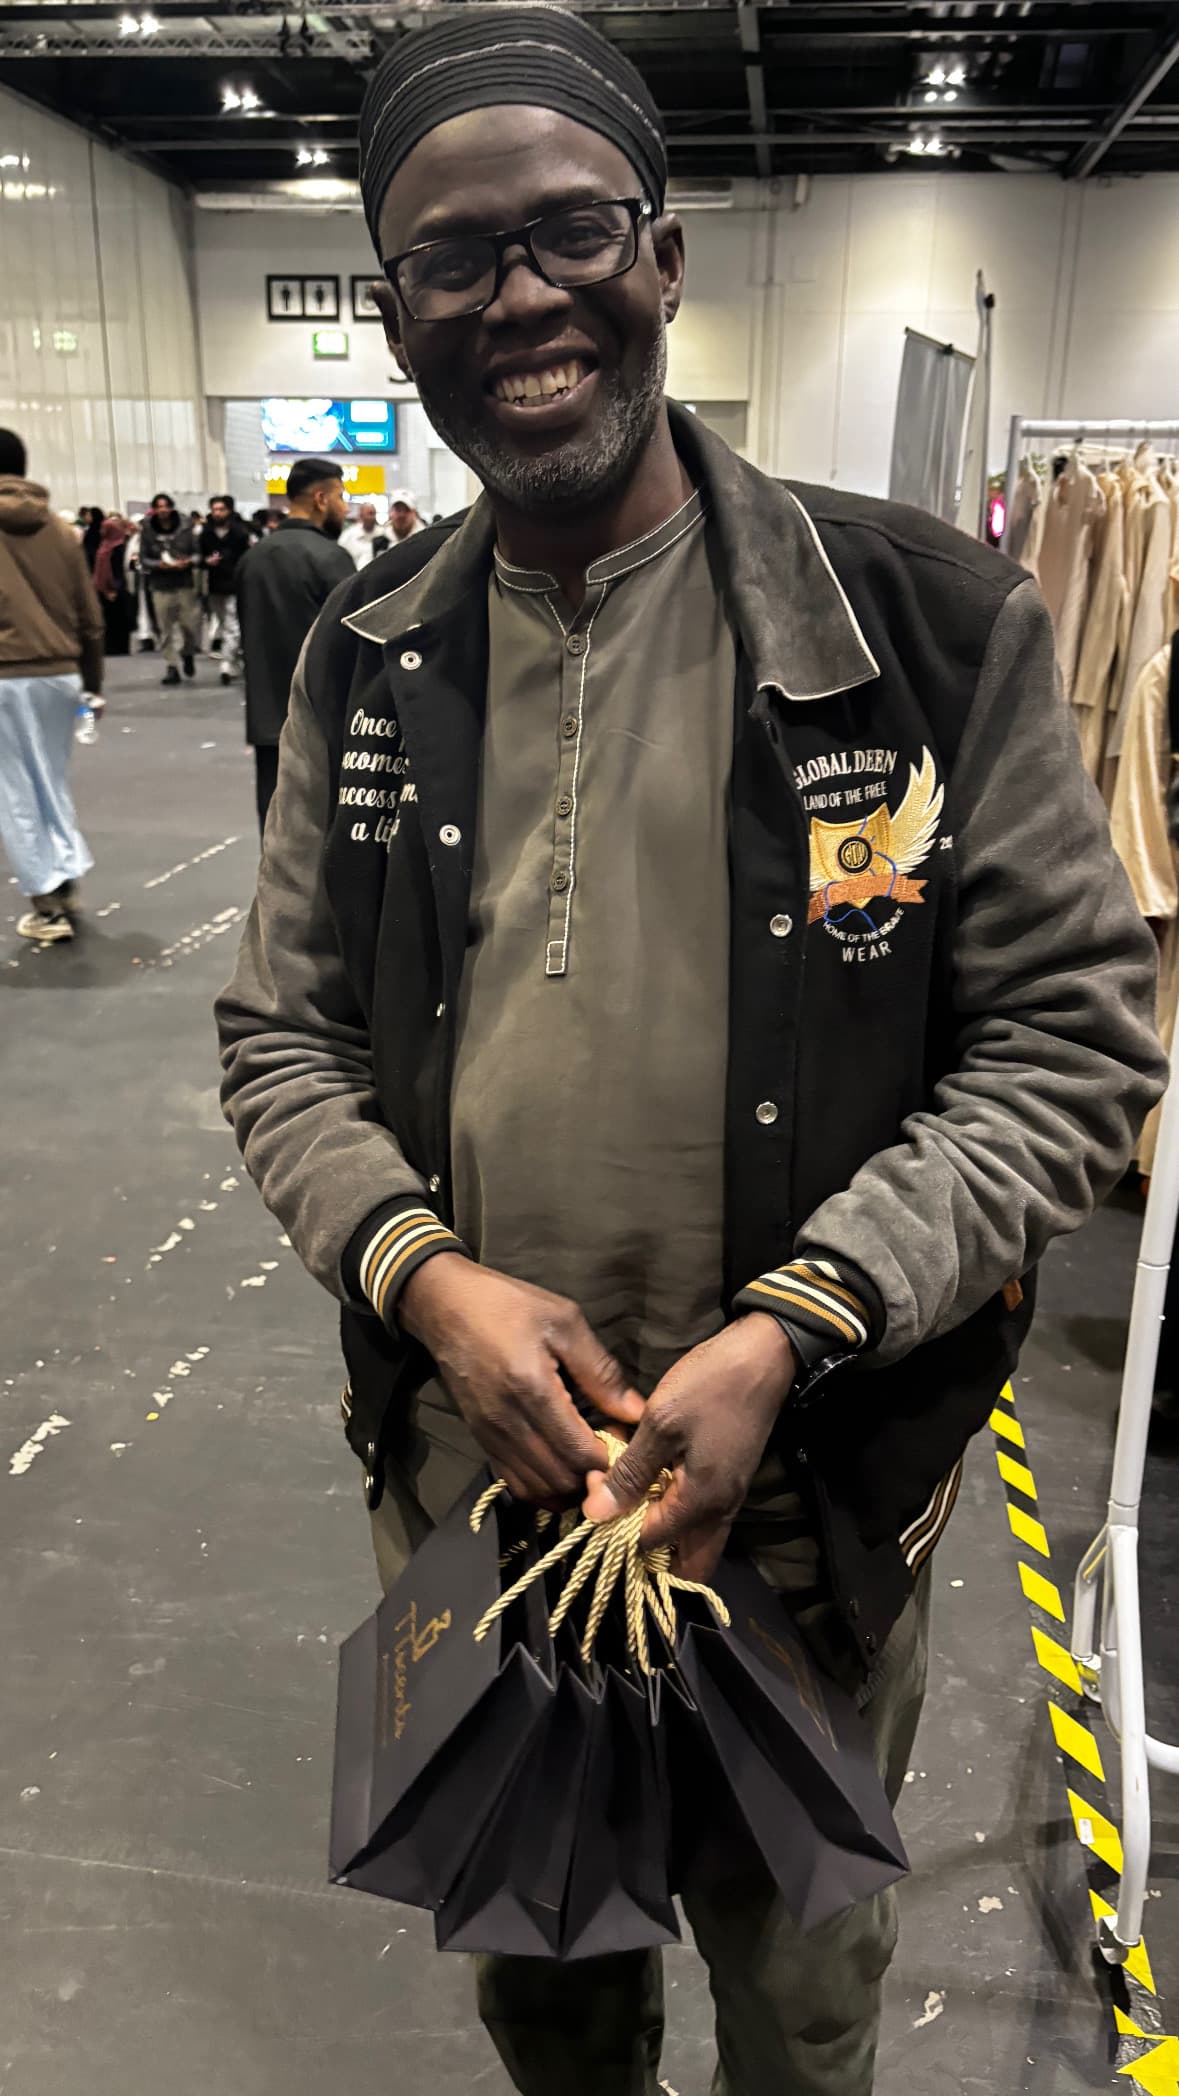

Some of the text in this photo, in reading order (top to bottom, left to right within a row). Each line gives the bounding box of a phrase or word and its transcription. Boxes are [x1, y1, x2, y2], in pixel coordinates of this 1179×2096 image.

[350, 708, 398, 738] Once
[853, 749, 898, 774] DEEN
[803, 780, 888, 811] LAND OF THE FREE
[350, 822, 369, 841] a
[822, 920, 847, 941] HOME
[847, 933, 861, 943] OF
[862, 930, 880, 942] THE
[842, 941, 893, 962] WEAR
